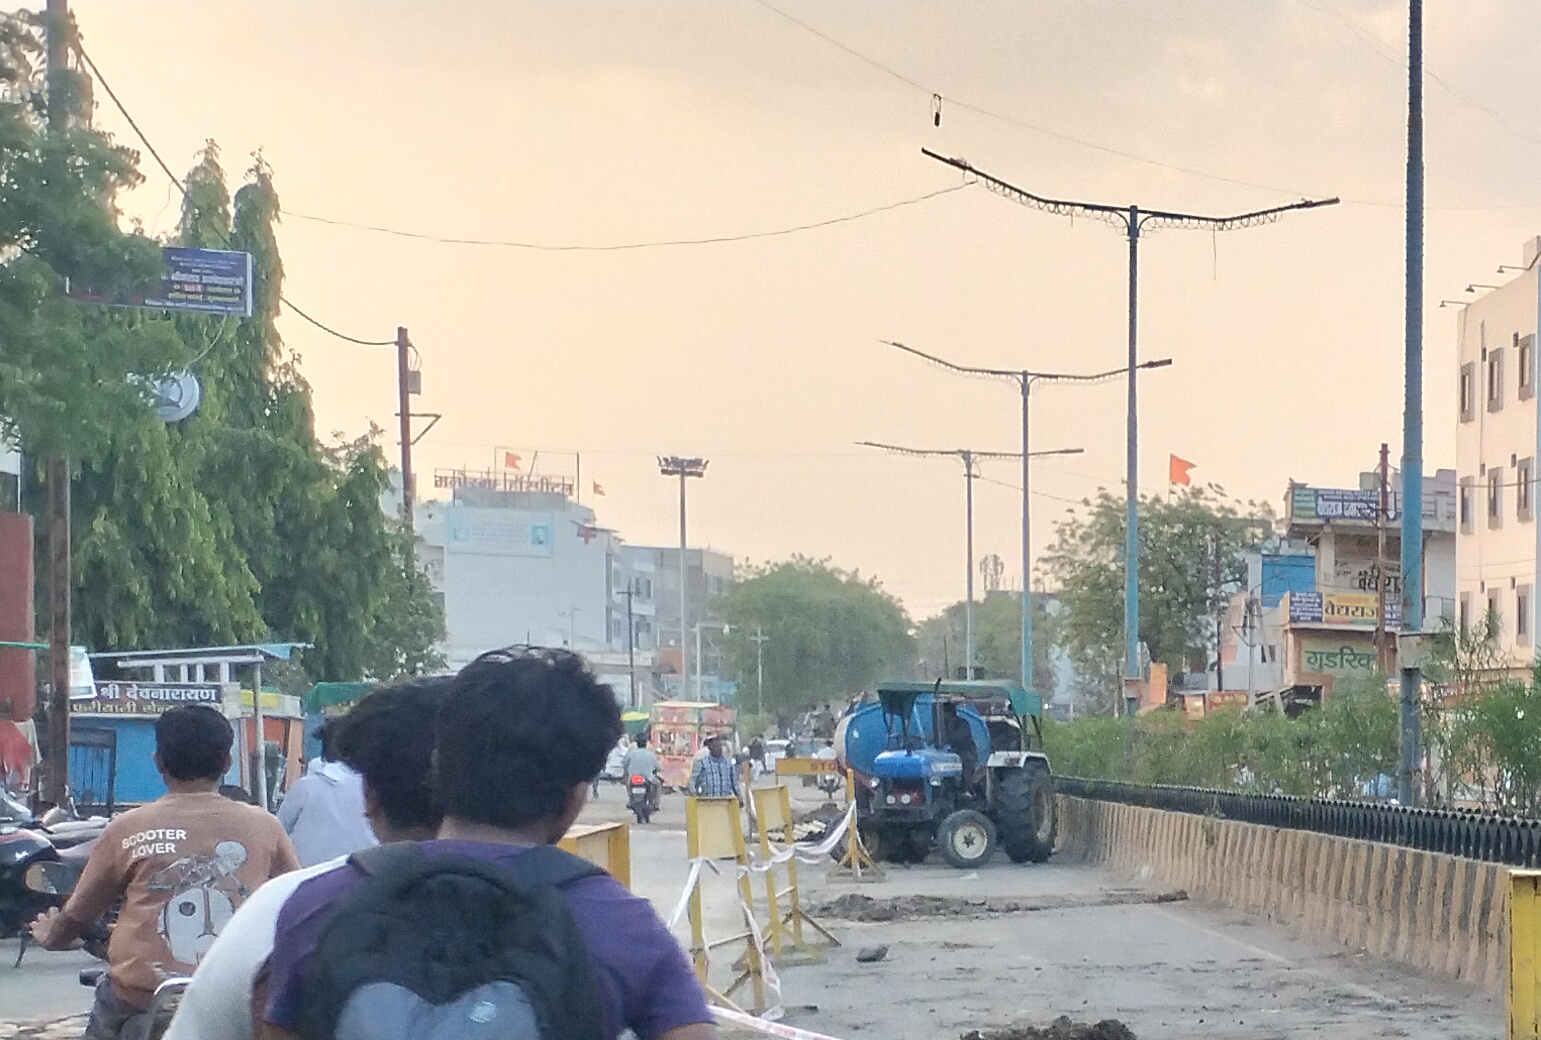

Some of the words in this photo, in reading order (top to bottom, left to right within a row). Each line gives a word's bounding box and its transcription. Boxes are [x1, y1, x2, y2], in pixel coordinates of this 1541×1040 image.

[100, 683, 120, 700] श्री
[125, 683, 217, 701] देवनारायण
[810, 761, 836, 772] STO
[121, 828, 188, 850] SCOOTER
[131, 842, 177, 860] LOVER
